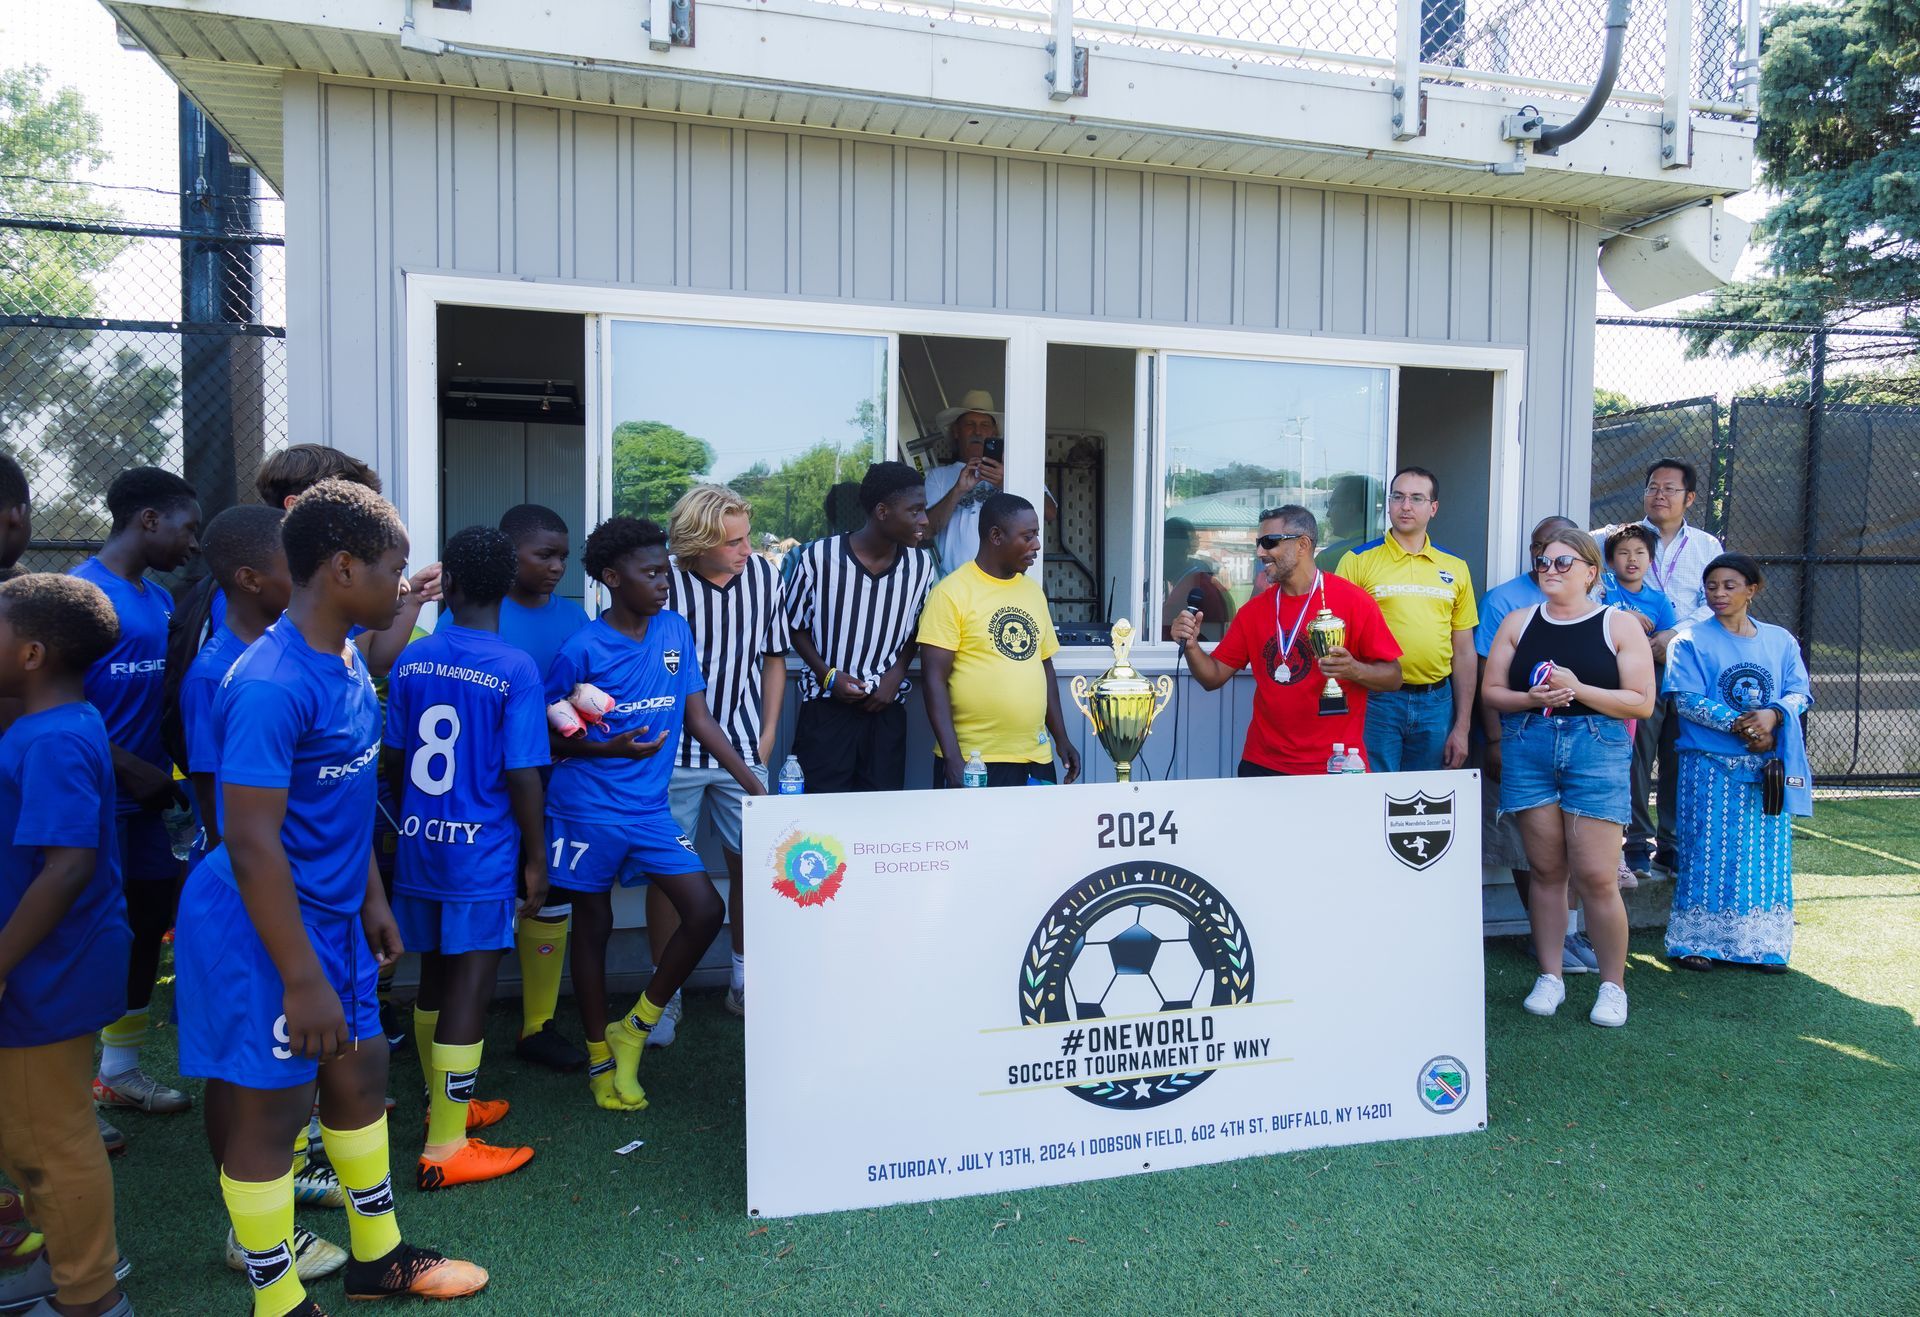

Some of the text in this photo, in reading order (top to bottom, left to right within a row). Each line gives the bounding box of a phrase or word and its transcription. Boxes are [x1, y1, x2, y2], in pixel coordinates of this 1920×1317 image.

[436, 663, 499, 689] MAENDELEO
[411, 704, 461, 796] 8
[425, 819, 482, 844] CITY
[1097, 810, 1178, 848] 2024
[552, 837, 590, 871] 17
[1061, 1015, 1214, 1056] #ONEWORLD
[1008, 1037, 1271, 1085] SOCCER TOURNAMENT OF WNY
[868, 1157, 952, 1182] SATURDAY,
[957, 1151, 994, 1172] JULY
[999, 1146, 1035, 1166] 13TH,
[1040, 1141, 1076, 1162] 2024
[1089, 1132, 1141, 1156] DOBSON
[1146, 1127, 1187, 1147] FIELD,
[1191, 1123, 1216, 1142] 602
[1220, 1119, 1245, 1138] 4TH
[1249, 1117, 1268, 1134] ST,
[1272, 1109, 1332, 1131] BUFFALO,
[1336, 1106, 1352, 1123] NY
[1356, 1102, 1393, 1121] 14201
